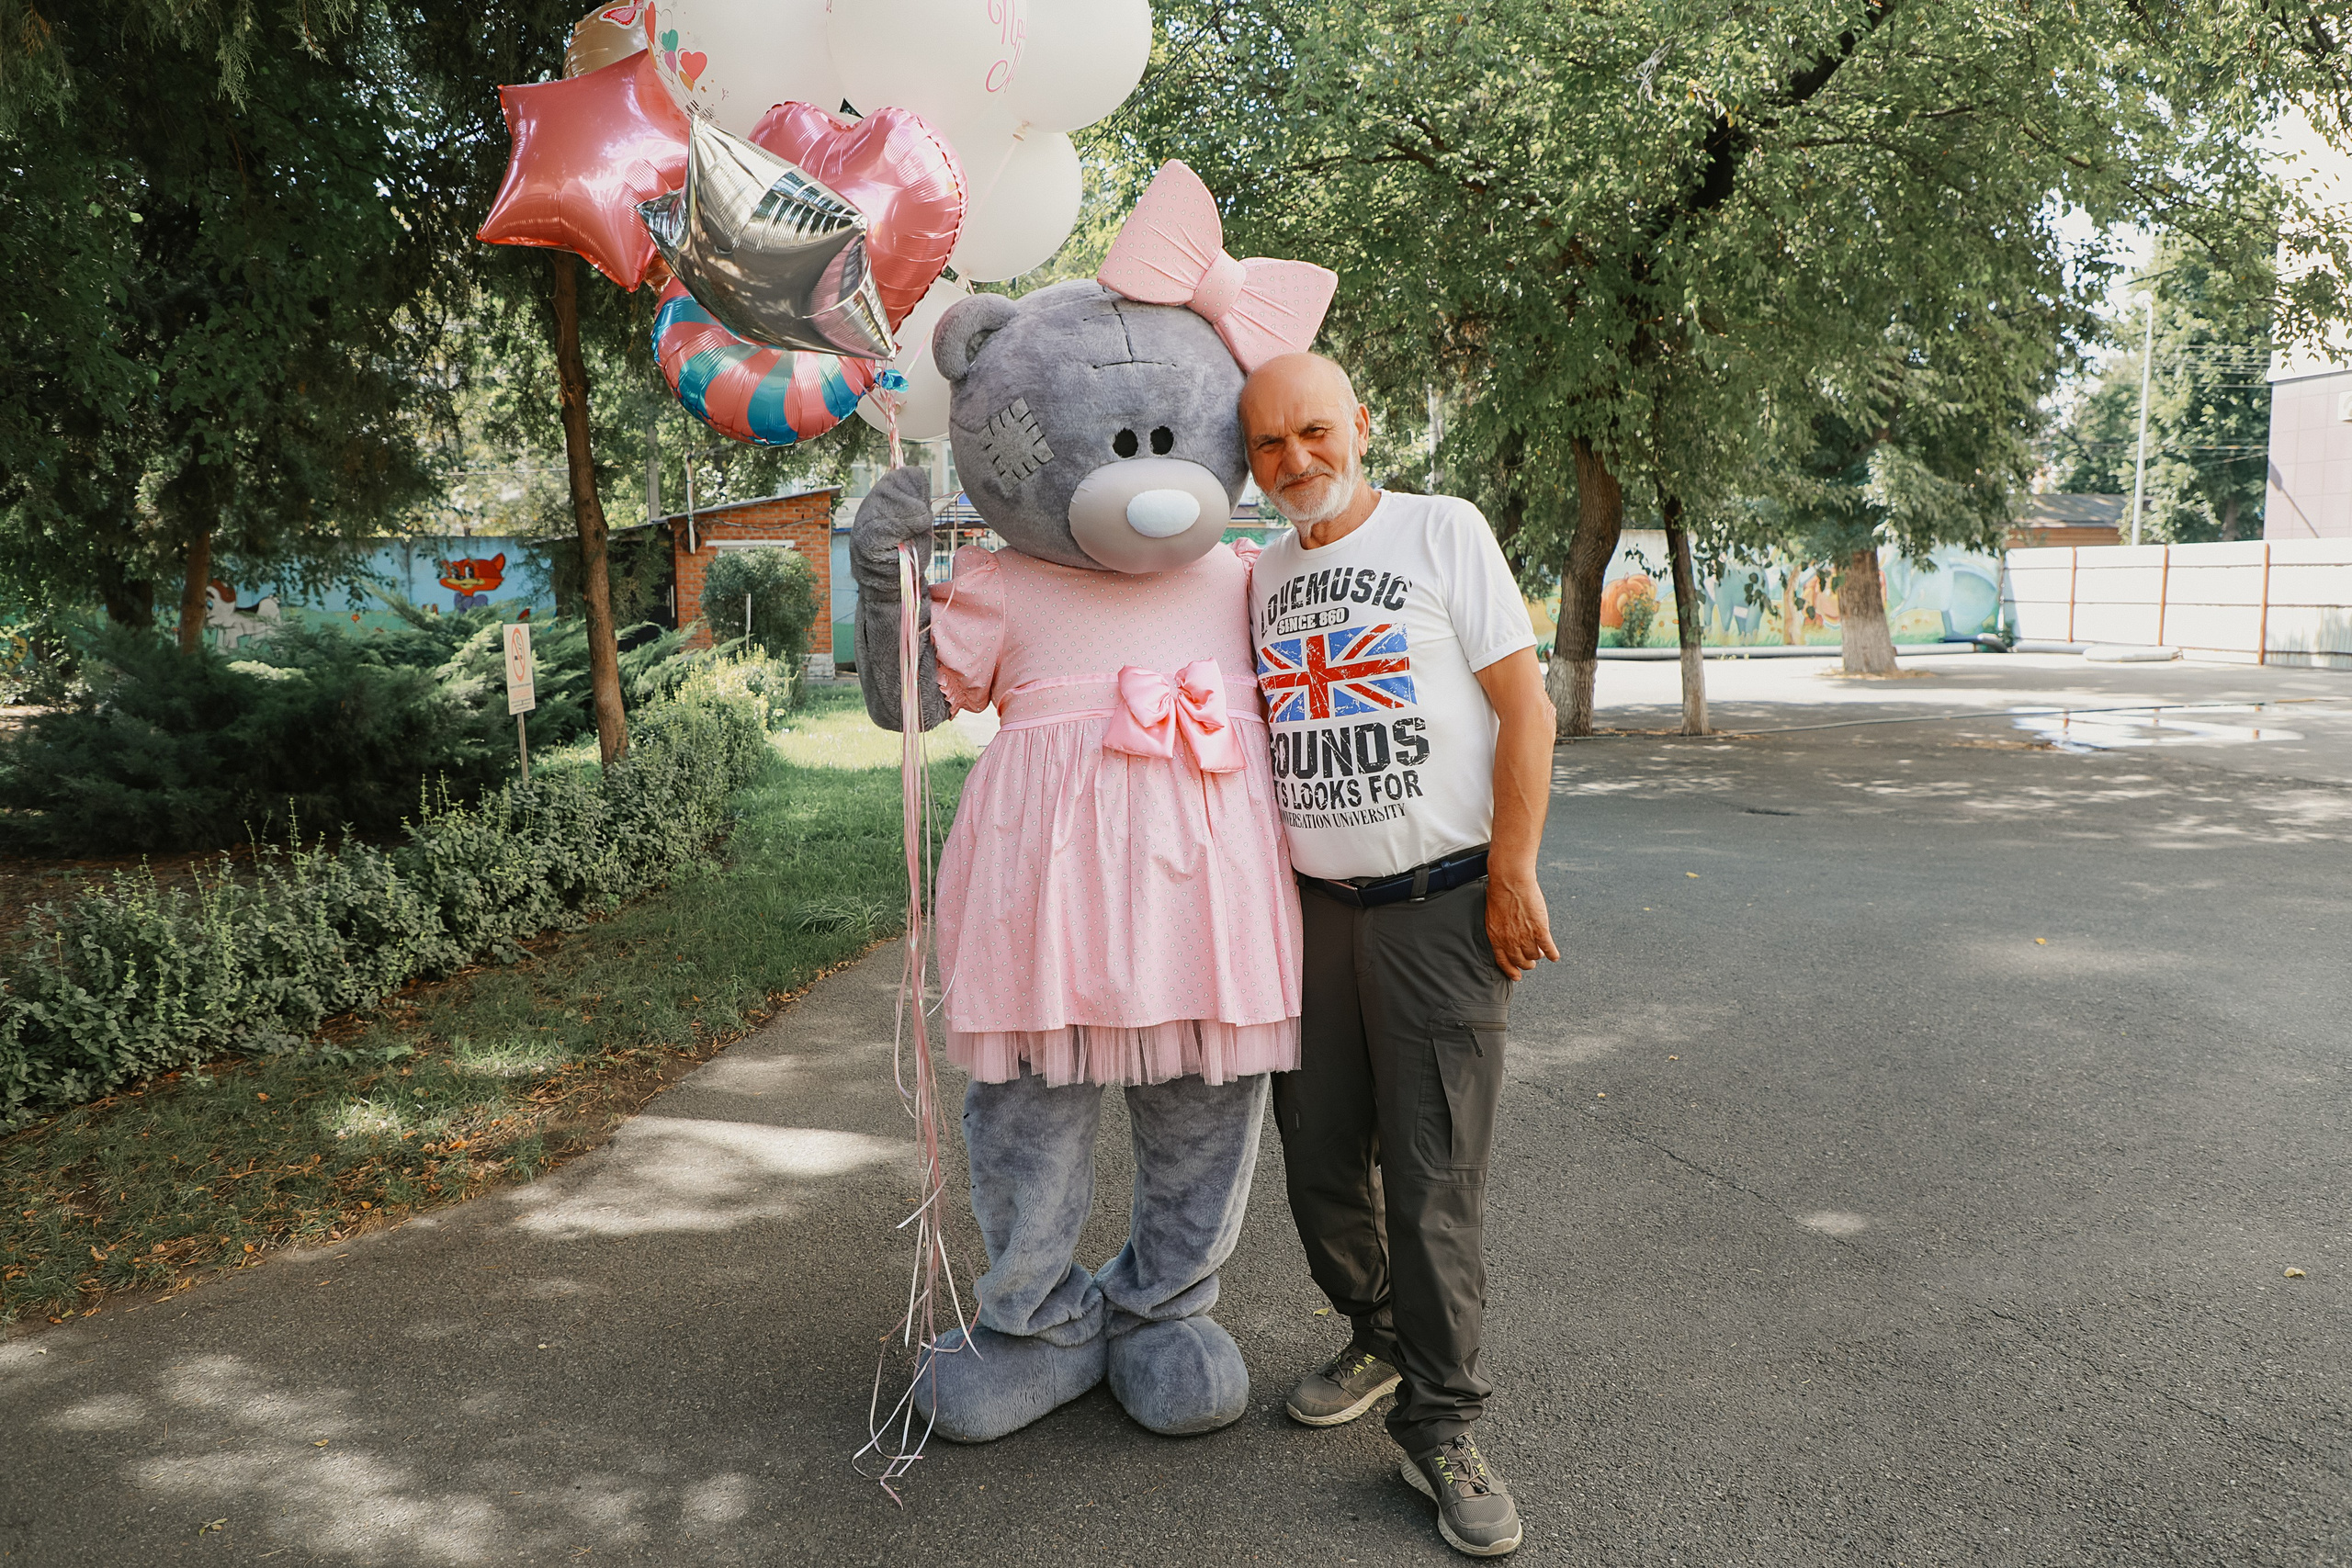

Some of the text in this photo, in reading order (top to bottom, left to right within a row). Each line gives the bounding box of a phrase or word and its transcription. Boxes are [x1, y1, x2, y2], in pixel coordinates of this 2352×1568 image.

[1278, 607, 1346, 635] SINCE 860
[1291, 779, 1362, 811] LOOKS
[1368, 770, 1423, 804] FOR
[1332, 803, 1406, 829] UNIVERSITY
